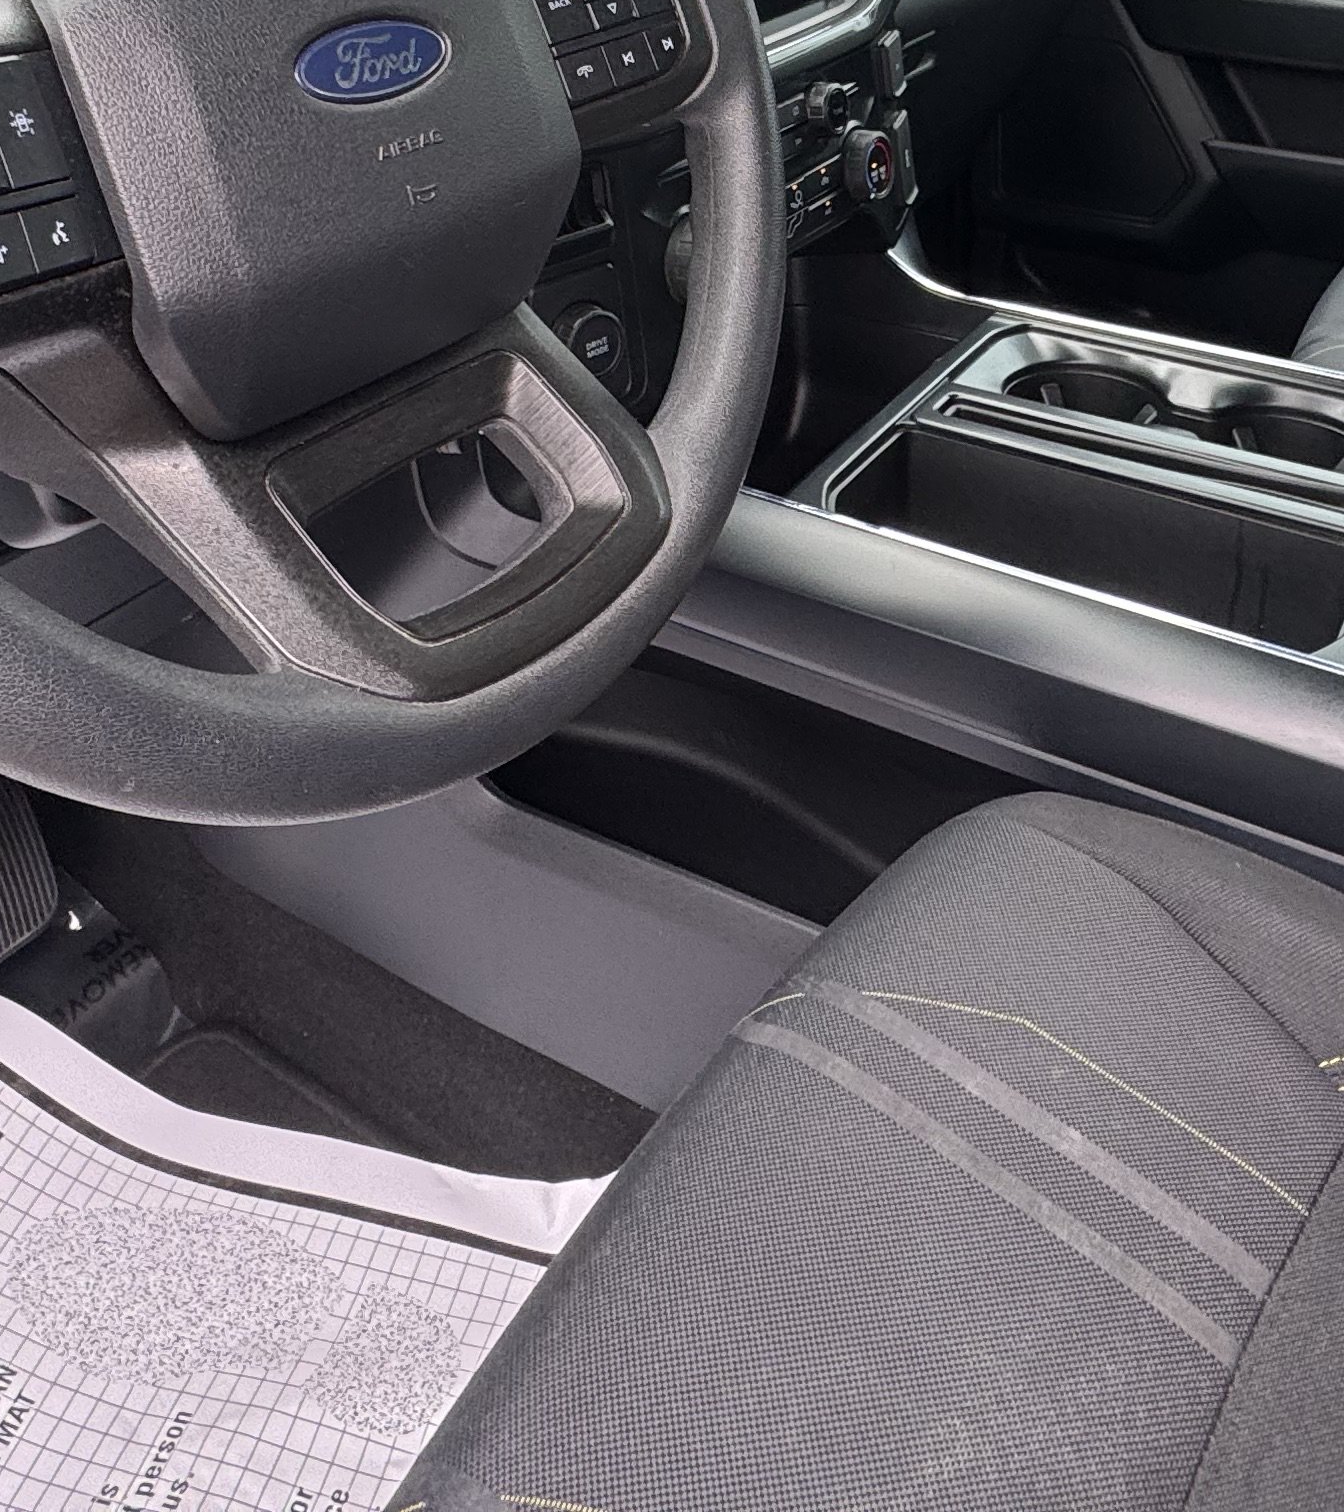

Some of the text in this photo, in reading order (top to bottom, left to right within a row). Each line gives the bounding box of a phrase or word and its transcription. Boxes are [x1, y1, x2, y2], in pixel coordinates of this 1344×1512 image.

[335, 33, 422, 89] Ford
[135, 1411, 193, 1498] person
[91, 1483, 119, 1506] is
